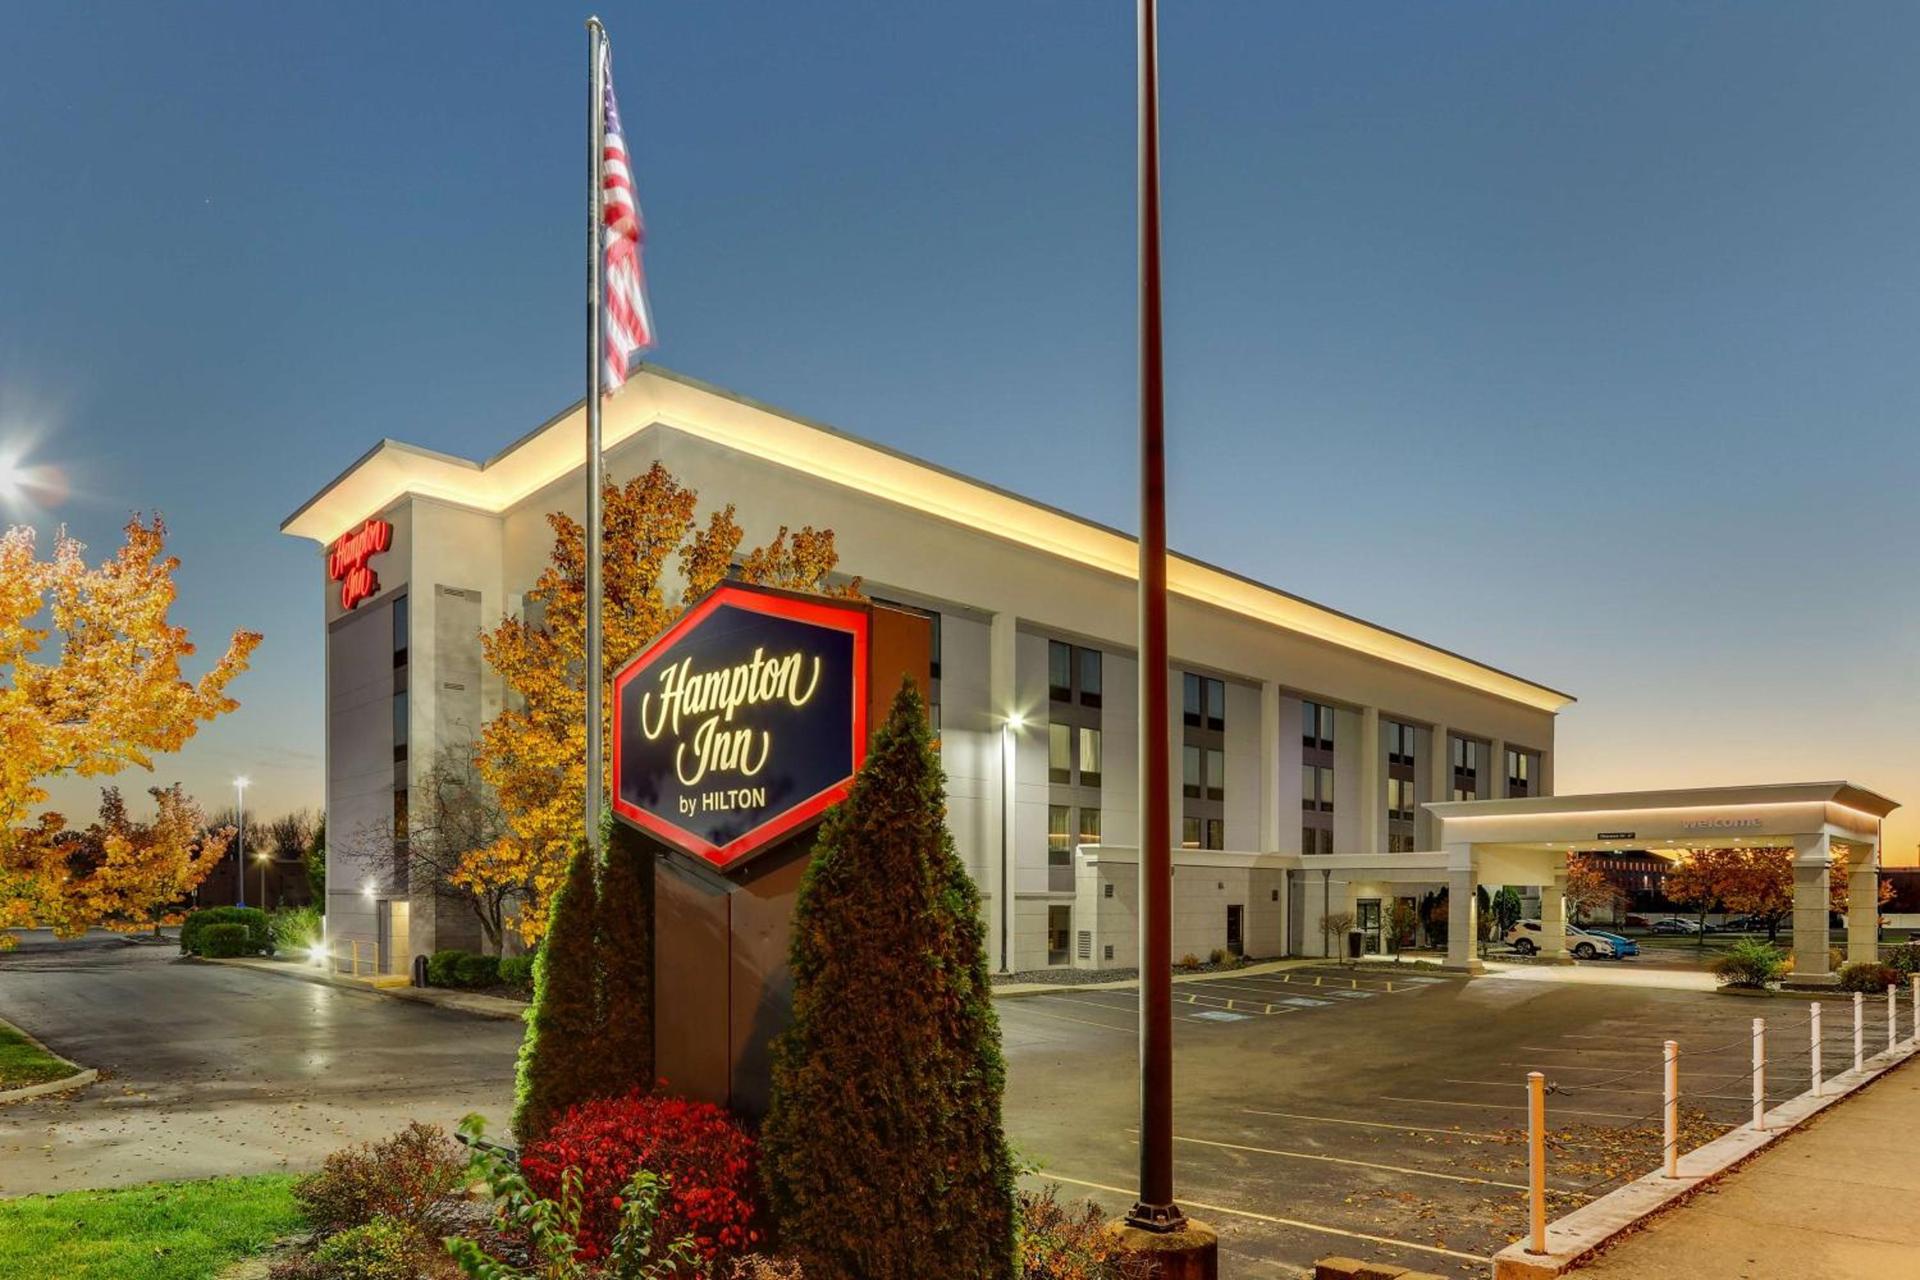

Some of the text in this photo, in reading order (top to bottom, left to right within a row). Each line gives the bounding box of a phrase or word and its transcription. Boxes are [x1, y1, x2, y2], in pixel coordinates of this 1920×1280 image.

[329, 519, 389, 580] Hampton
[642, 648, 819, 739] Hampton
[677, 716, 769, 785] Inn
[679, 788, 765, 817] by HILTON
